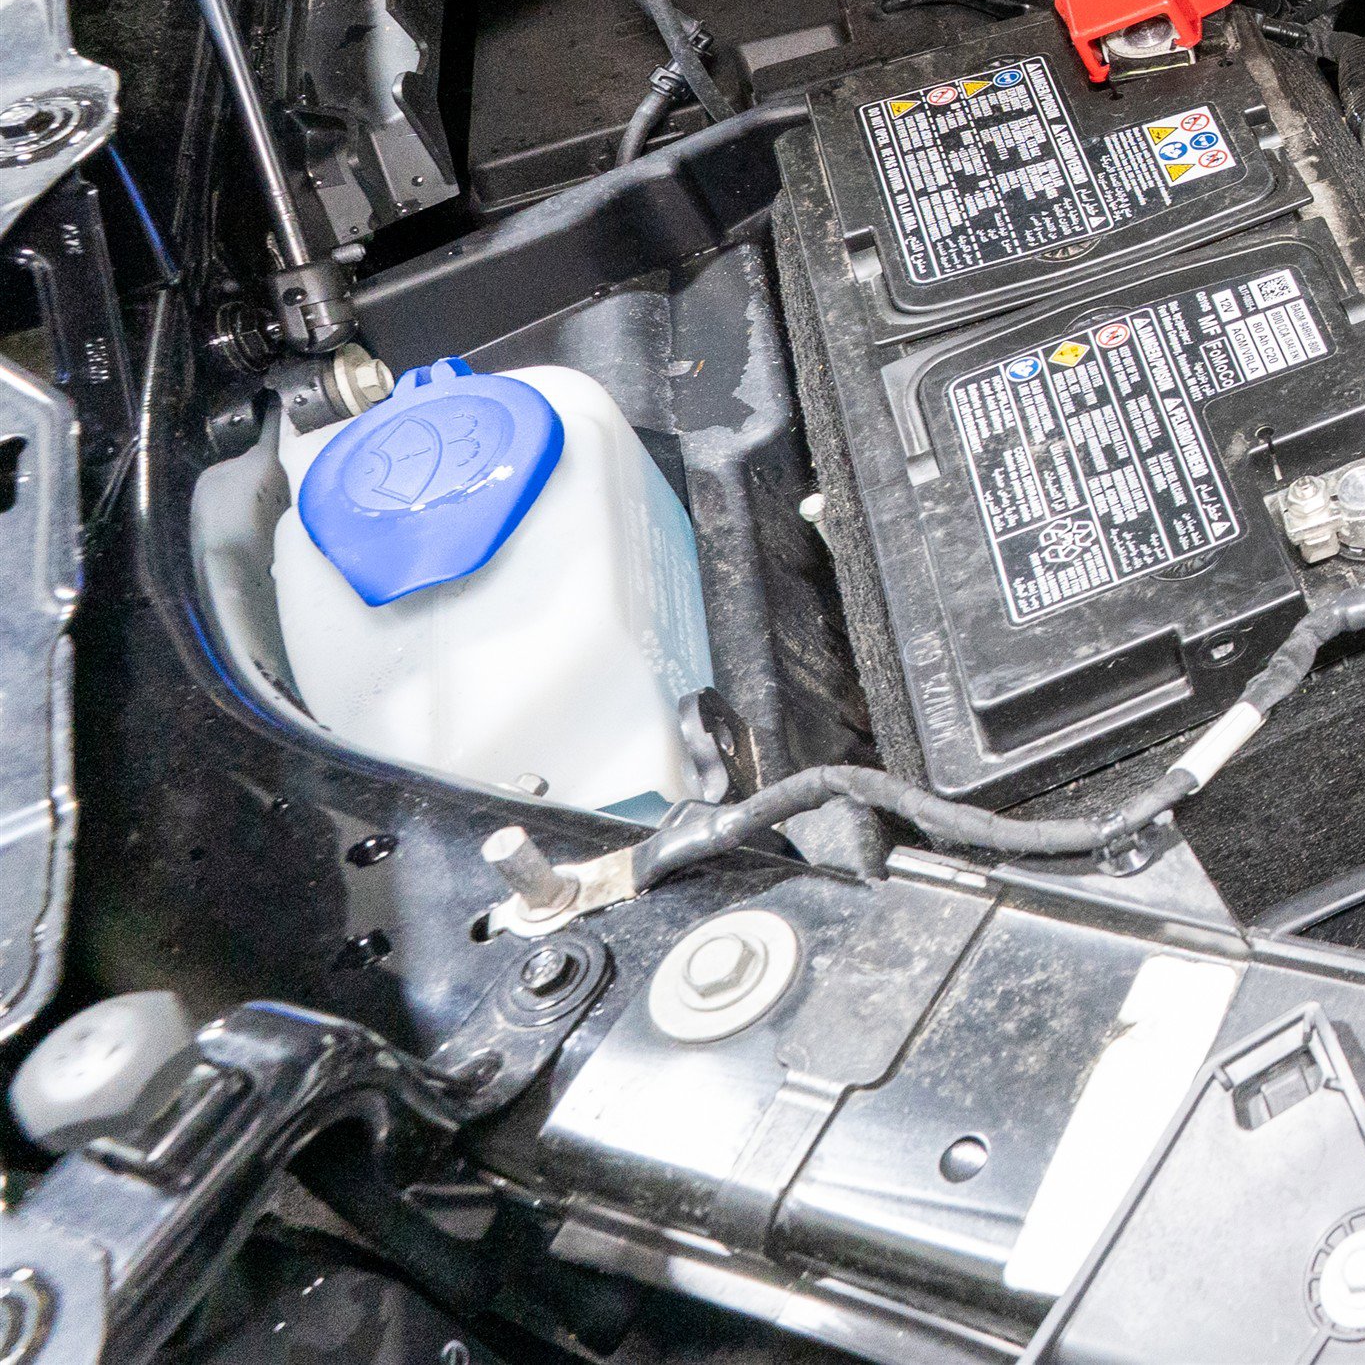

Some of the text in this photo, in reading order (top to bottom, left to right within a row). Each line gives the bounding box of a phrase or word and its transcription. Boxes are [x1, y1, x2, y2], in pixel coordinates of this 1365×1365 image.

[1027, 68, 1062, 119] DANGER/POISON
[866, 106, 890, 147] DO NOT OPEN.
[880, 146, 894, 157] NE
[882, 155, 898, 169] PAS
[1053, 129, 1089, 185] PELIGRO/VENENO
[894, 192, 909, 204] NO
[898, 202, 912, 214] LA
[1218, 297, 1234, 314] 12V
[1269, 310, 1285, 325] 800
[1196, 313, 1223, 338] MF
[1275, 323, 1291, 338] CCA
[1230, 326, 1260, 374] AGM/VRLA
[1251, 320, 1279, 364] 80 Ah C20
[1134, 324, 1178, 393] DANGER/POISON
[1204, 340, 1238, 388] FoMoCo
[954, 386, 968, 405] ANTI
[979, 377, 993, 396] Lead
[984, 393, 998, 411] Acid
[990, 374, 1016, 429] NON-SPILLABLE
[1165, 405, 1212, 479] PELIGRO/VENENO
[1012, 445, 1031, 477] CONTRA
